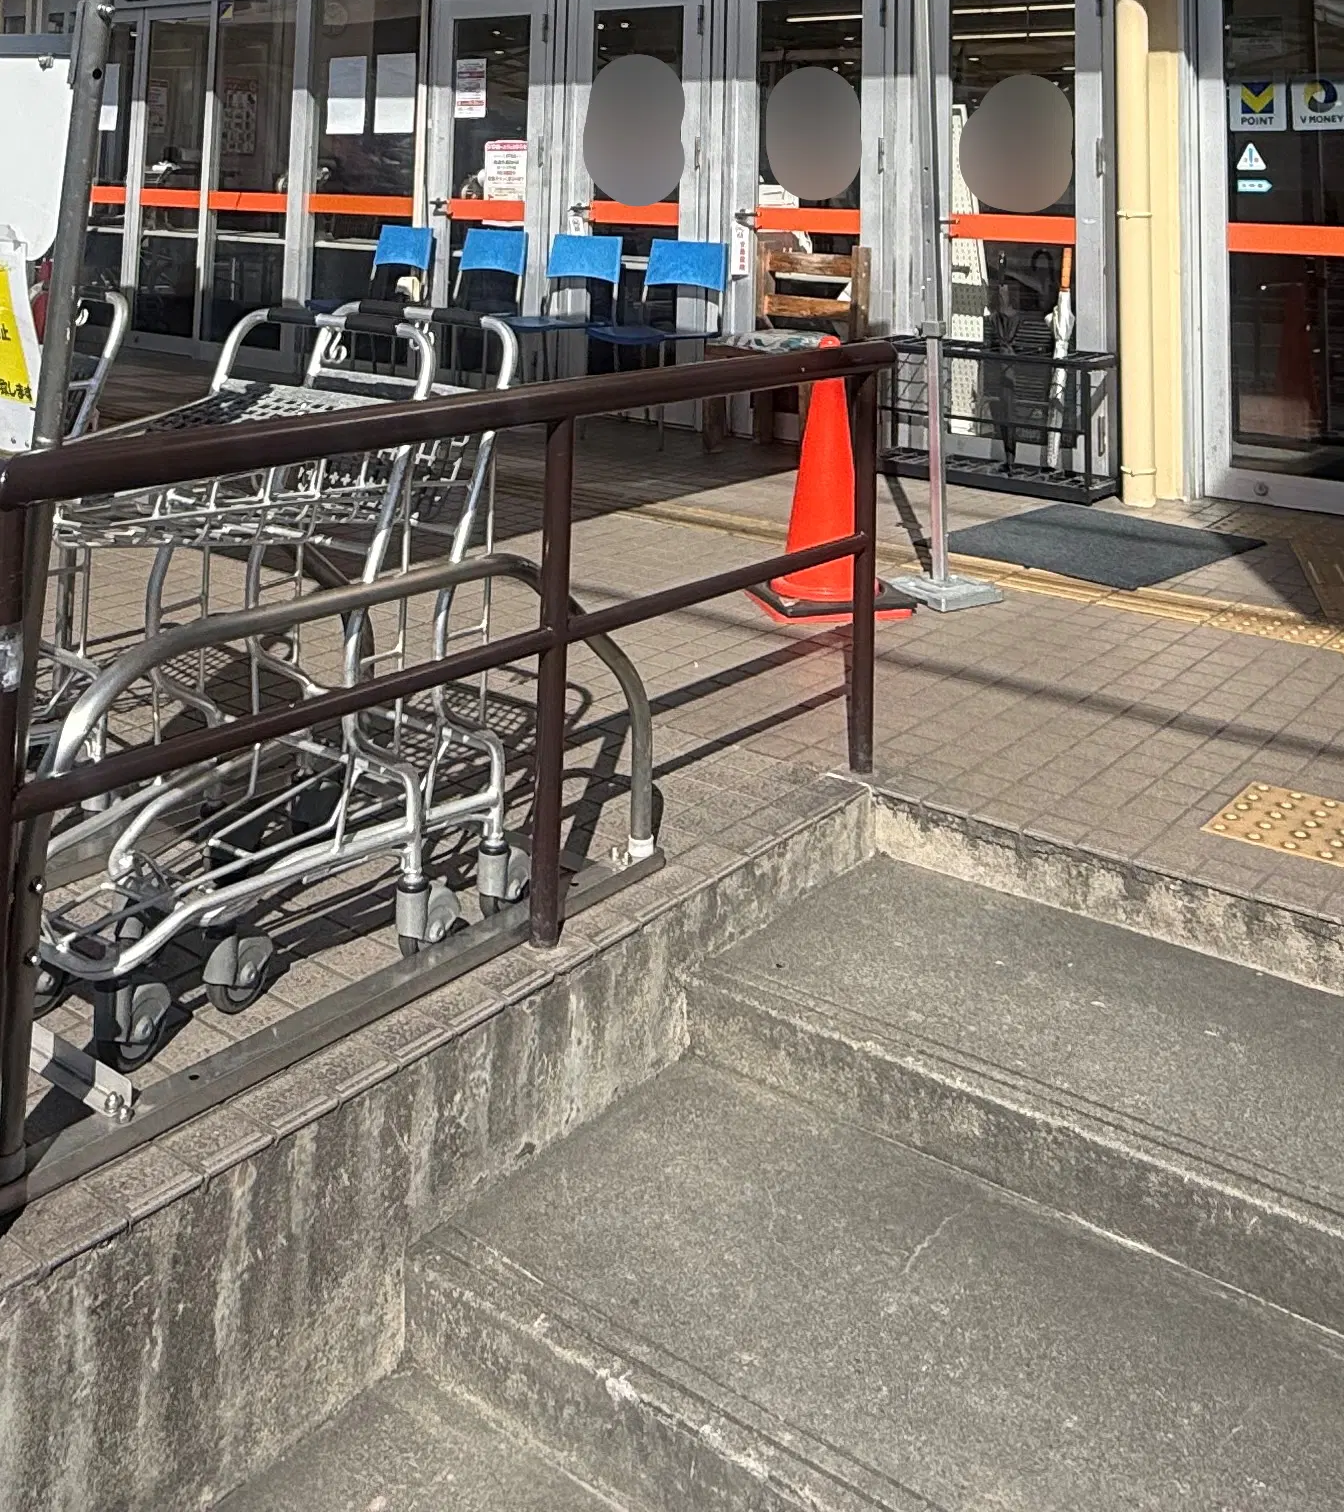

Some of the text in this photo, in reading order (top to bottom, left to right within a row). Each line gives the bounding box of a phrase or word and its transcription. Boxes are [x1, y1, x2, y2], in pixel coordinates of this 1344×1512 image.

[1240, 116, 1274, 126] POINT
[1300, 114, 1344, 124] V MONEY
